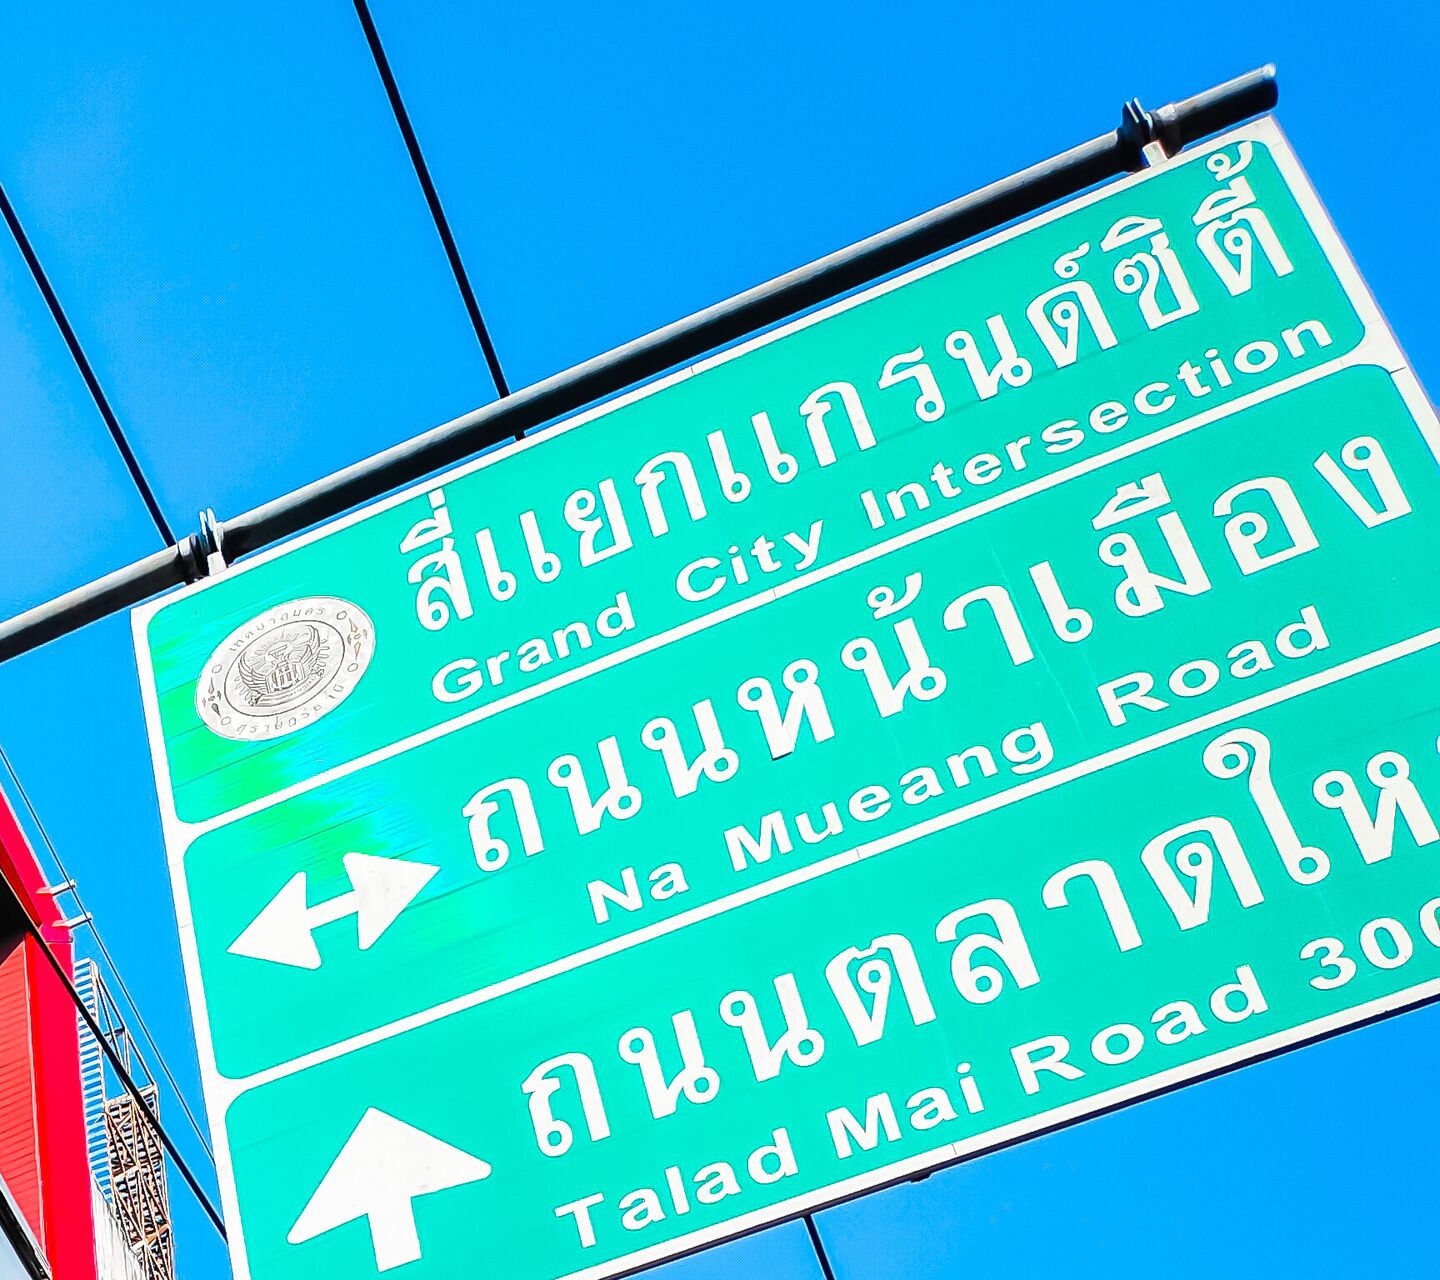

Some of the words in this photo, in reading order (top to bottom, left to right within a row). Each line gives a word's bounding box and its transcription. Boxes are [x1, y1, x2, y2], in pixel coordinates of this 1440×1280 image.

[401, 138, 1295, 634] สี่แยกแกรนด์ซิตี้
[430, 593, 636, 711] Grand
[676, 513, 825, 606] City
[861, 314, 1334, 527] Intersection
[462, 434, 1414, 874] ถนนหน้าเมือง
[589, 857, 690, 926] Na
[722, 715, 1057, 866] Mueang
[1098, 605, 1331, 729] Road
[520, 727, 1440, 1164] ถนนตลาดให
[555, 1126, 800, 1253] Talad
[828, 1059, 987, 1161] Mai
[1011, 963, 1268, 1096] Road
